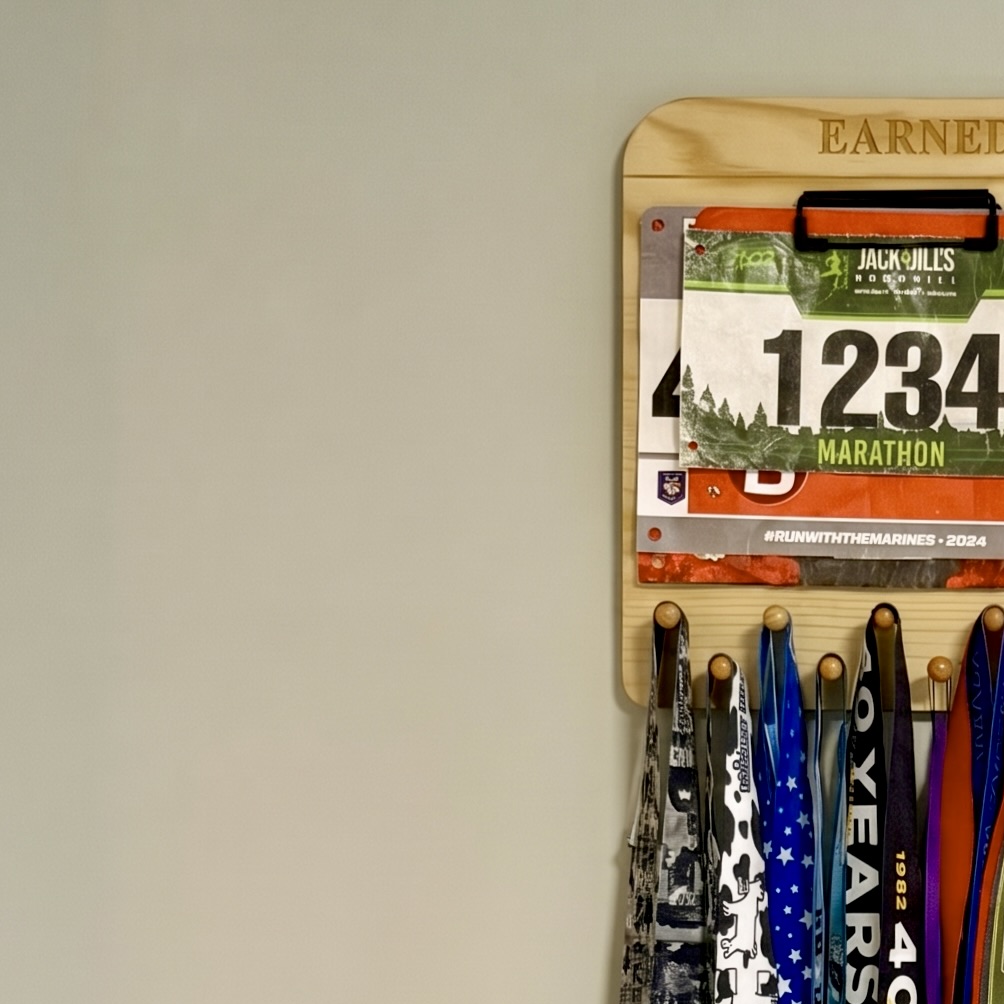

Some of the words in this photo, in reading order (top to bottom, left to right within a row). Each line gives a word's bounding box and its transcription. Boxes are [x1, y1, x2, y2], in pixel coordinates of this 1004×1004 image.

[817, 438, 946, 469] MARATHON
[763, 529, 935, 547] #RUNWITHTHEMARINES
[945, 532, 987, 549] 2024
[895, 850, 907, 911] 1982
